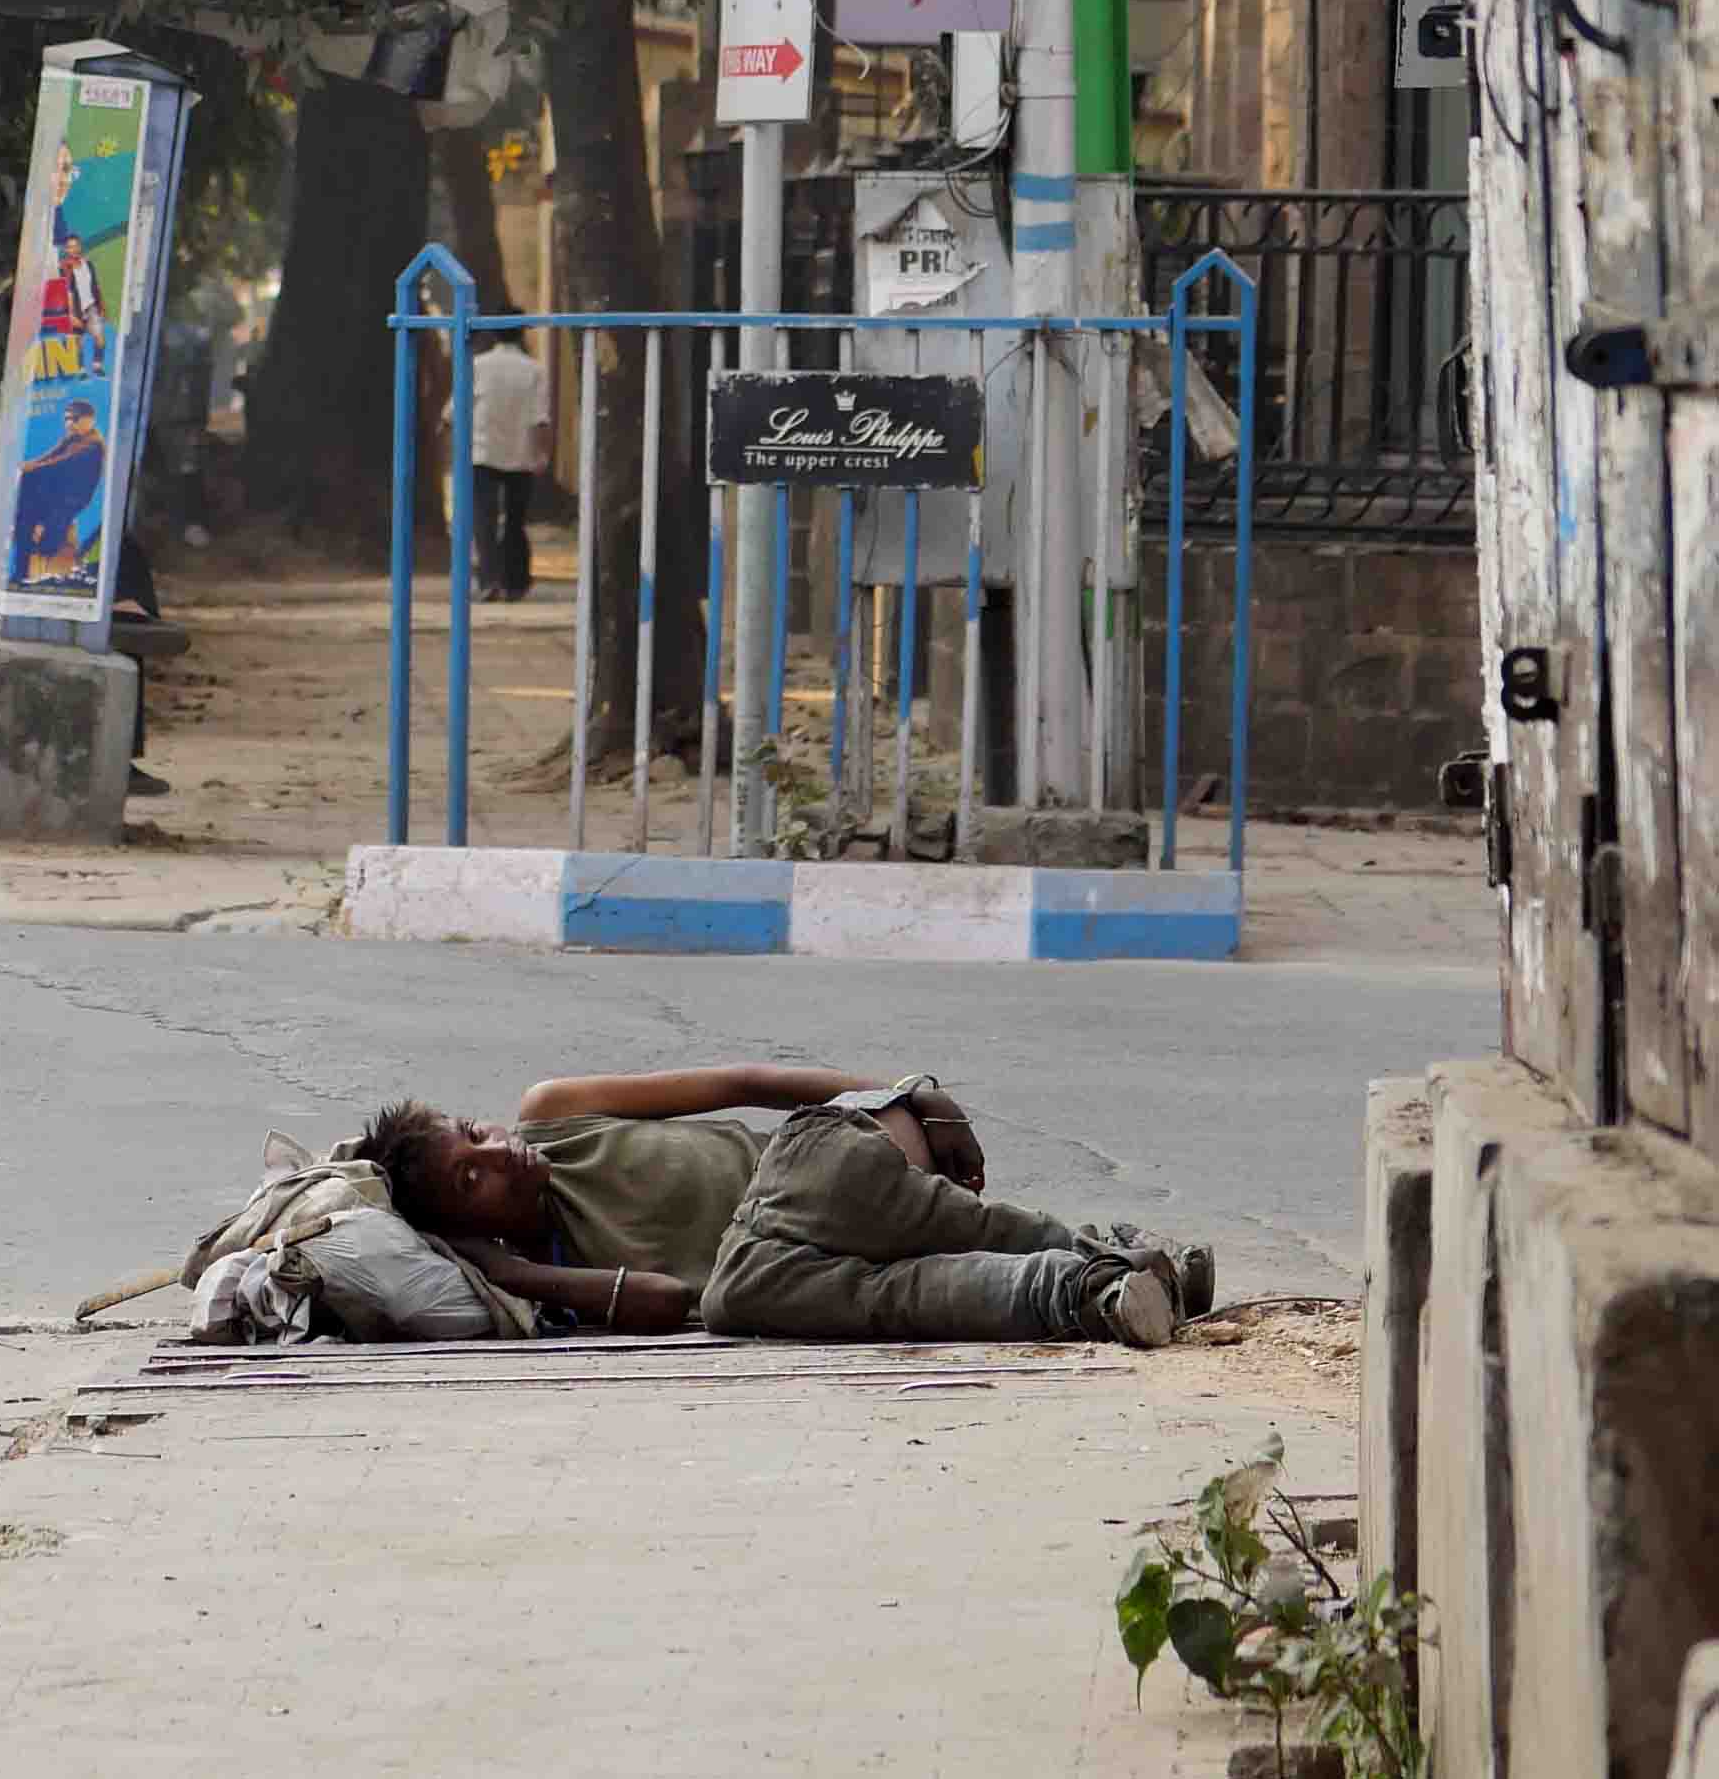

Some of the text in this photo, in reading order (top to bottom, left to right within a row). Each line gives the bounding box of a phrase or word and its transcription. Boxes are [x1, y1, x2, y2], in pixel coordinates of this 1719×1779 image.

[743, 47, 778, 73] WAY
[759, 407, 945, 459] Louis Philippe
[744, 452, 890, 470] The upper crest
